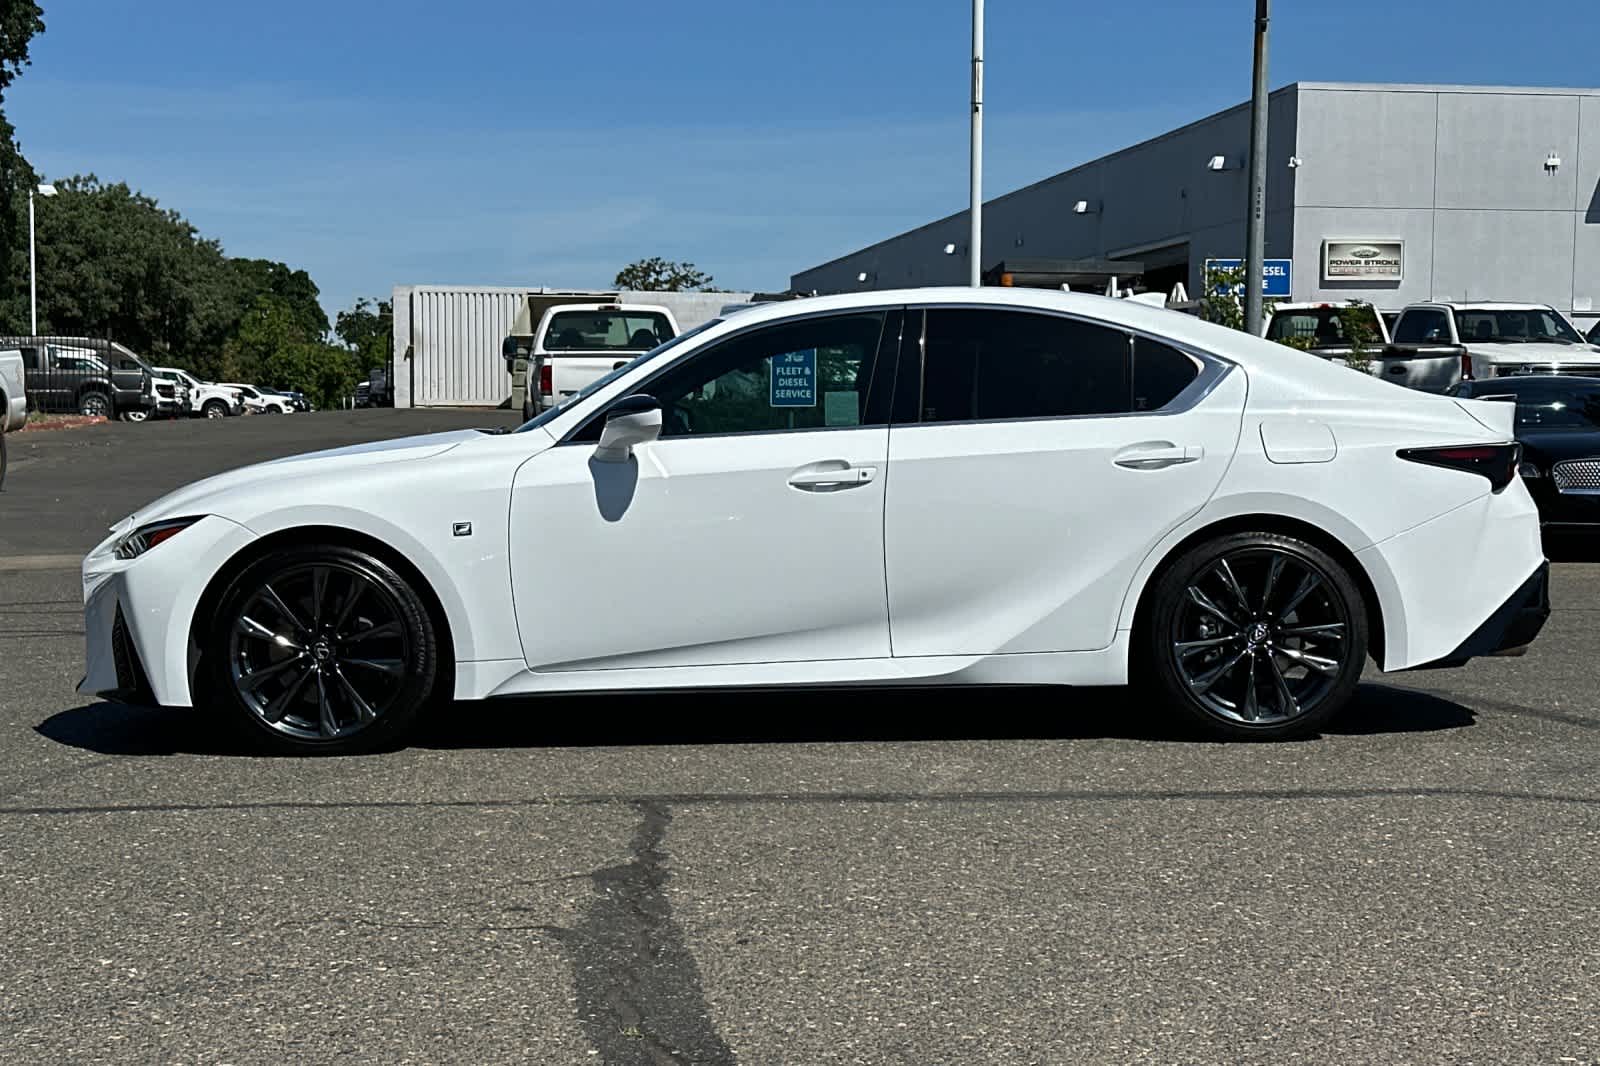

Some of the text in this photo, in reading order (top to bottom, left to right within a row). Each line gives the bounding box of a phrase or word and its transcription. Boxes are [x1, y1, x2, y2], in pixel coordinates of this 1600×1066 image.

[776, 366, 811, 376] FLEET &
[778, 378, 808, 387] DIESEL
[775, 389, 812, 399] SERVICE
